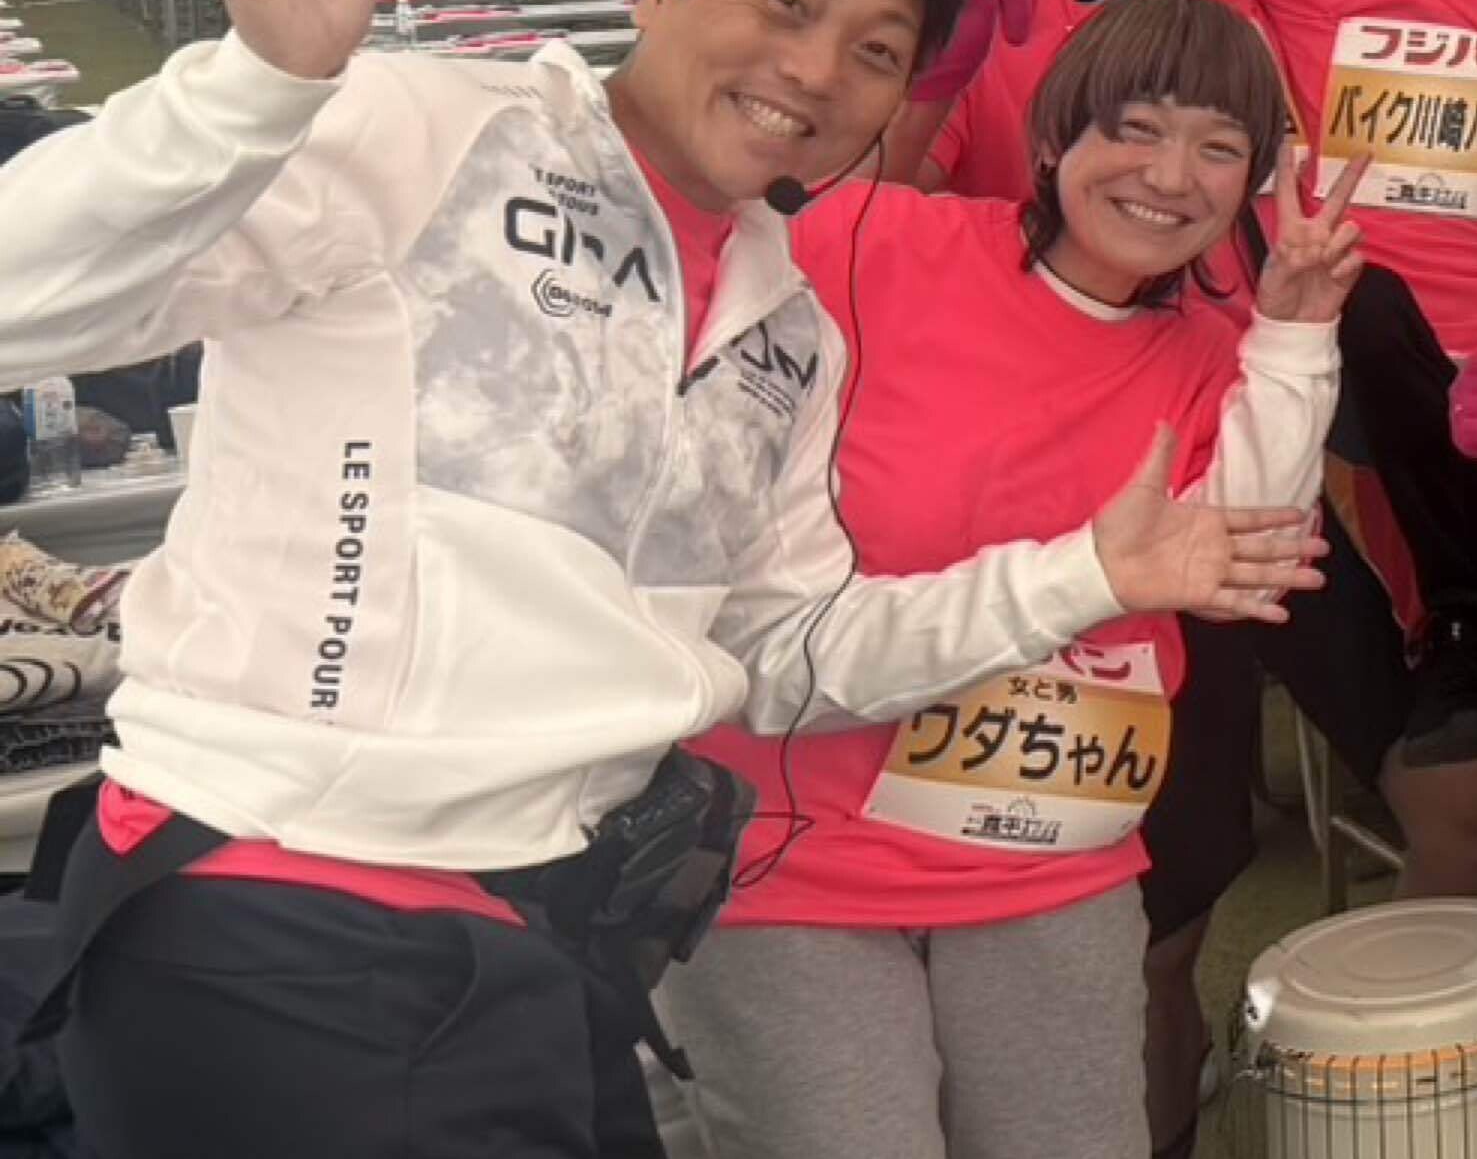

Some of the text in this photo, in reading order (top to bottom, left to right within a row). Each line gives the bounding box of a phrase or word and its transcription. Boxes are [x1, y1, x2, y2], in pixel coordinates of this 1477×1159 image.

[309, 442, 371, 708] LE SPORT POUR
[1007, 675, 1078, 705] 女と男
[907, 704, 1156, 790] ワダちゃん
